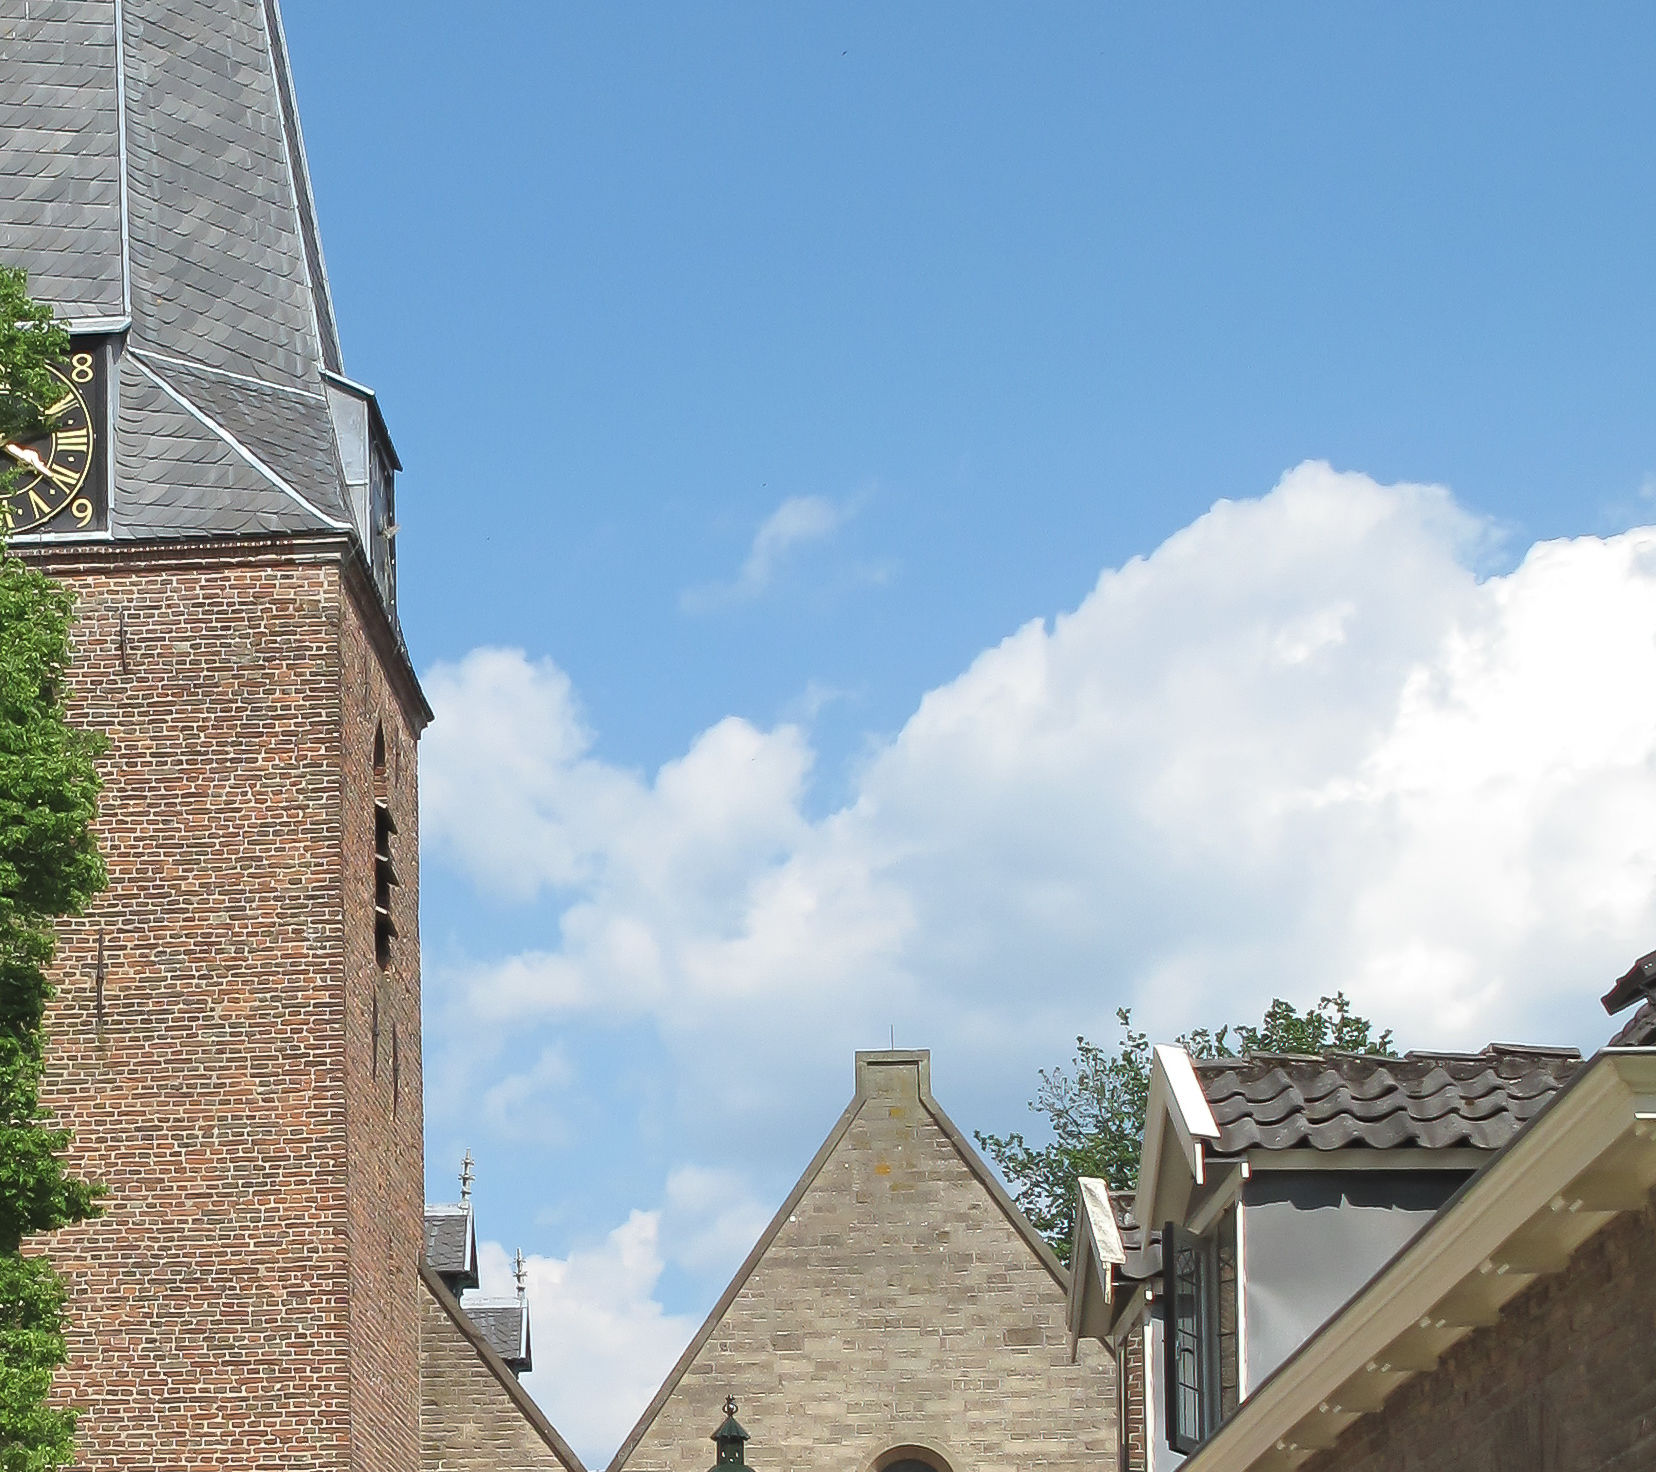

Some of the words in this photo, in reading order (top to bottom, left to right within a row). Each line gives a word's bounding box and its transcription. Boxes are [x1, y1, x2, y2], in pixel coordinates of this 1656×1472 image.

[71, 353, 94, 383] 8
[56, 427, 88, 453] III
[71, 498, 94, 528] 9
